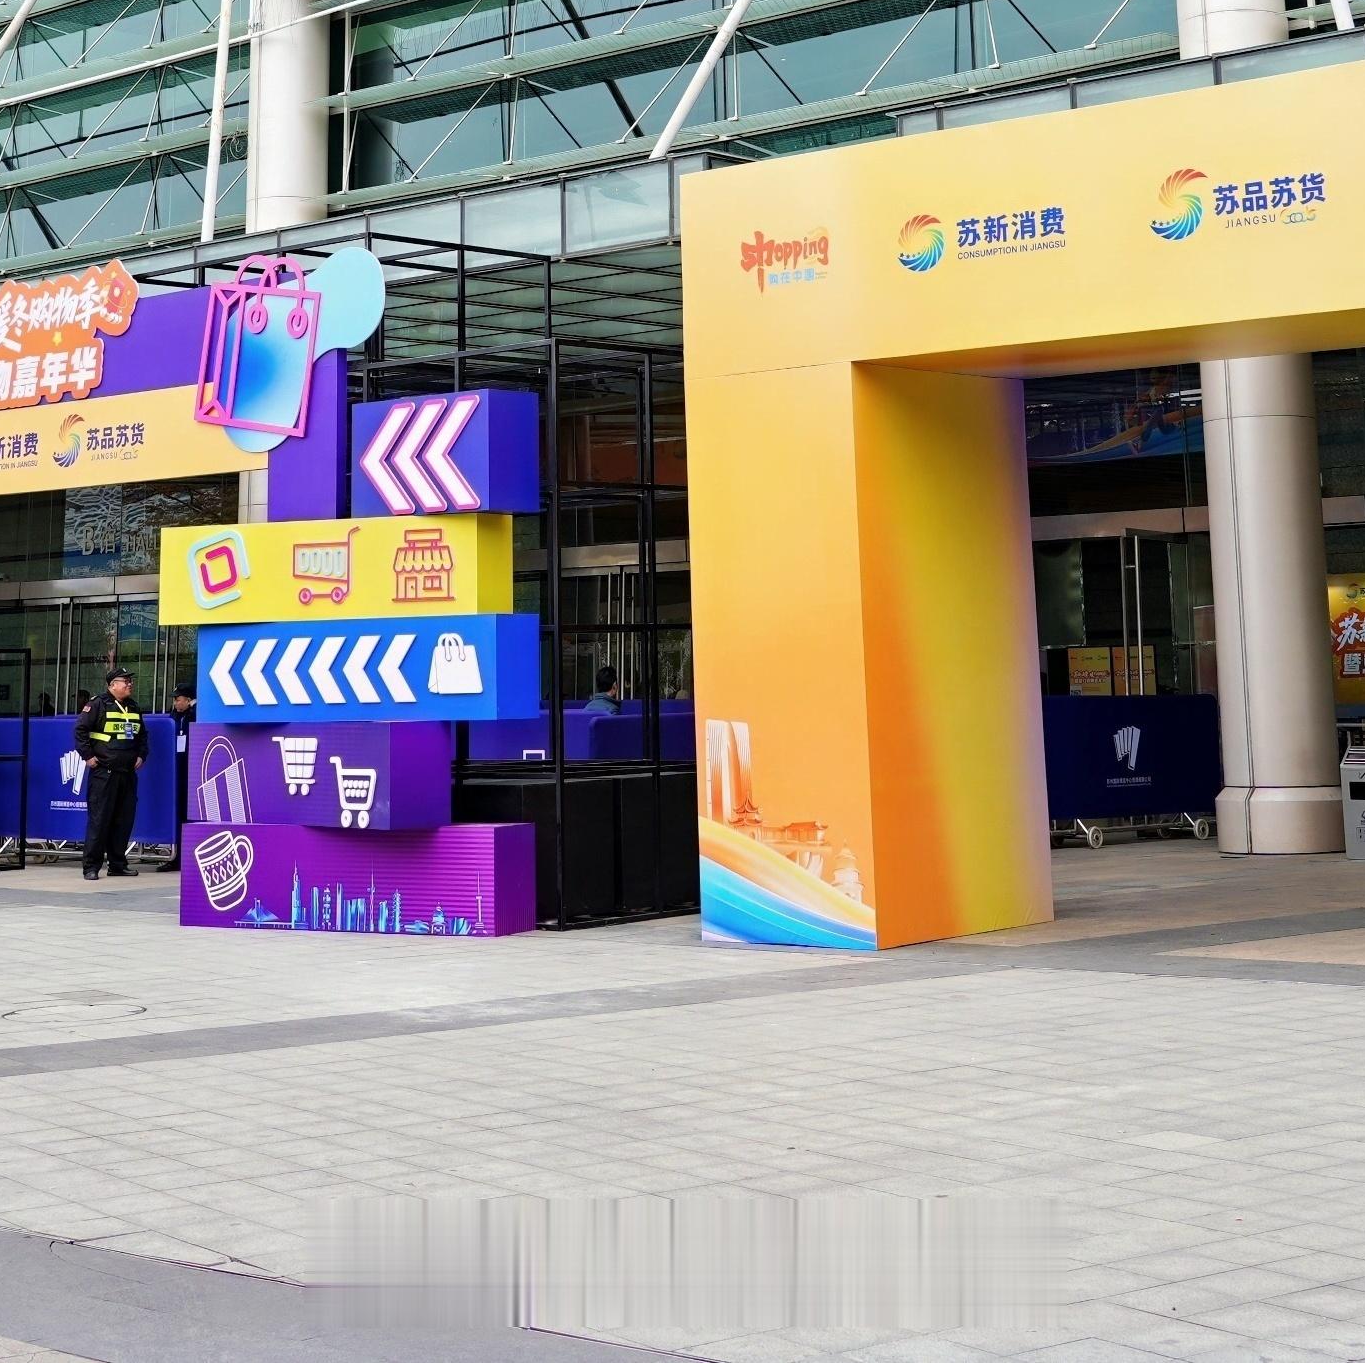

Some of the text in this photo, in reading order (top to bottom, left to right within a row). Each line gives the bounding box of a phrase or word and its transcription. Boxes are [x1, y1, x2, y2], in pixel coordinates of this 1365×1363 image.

[1213, 173, 1326, 216] 苏品苏货
[957, 207, 1066, 248] 苏新消费
[1225, 214, 1276, 229] JIANGSU
[958, 240, 1066, 260] CONSUMPTION IN JIANGSU
[87, 423, 145, 451] 苏品苏货
[91, 451, 118, 462] JIANGSU
